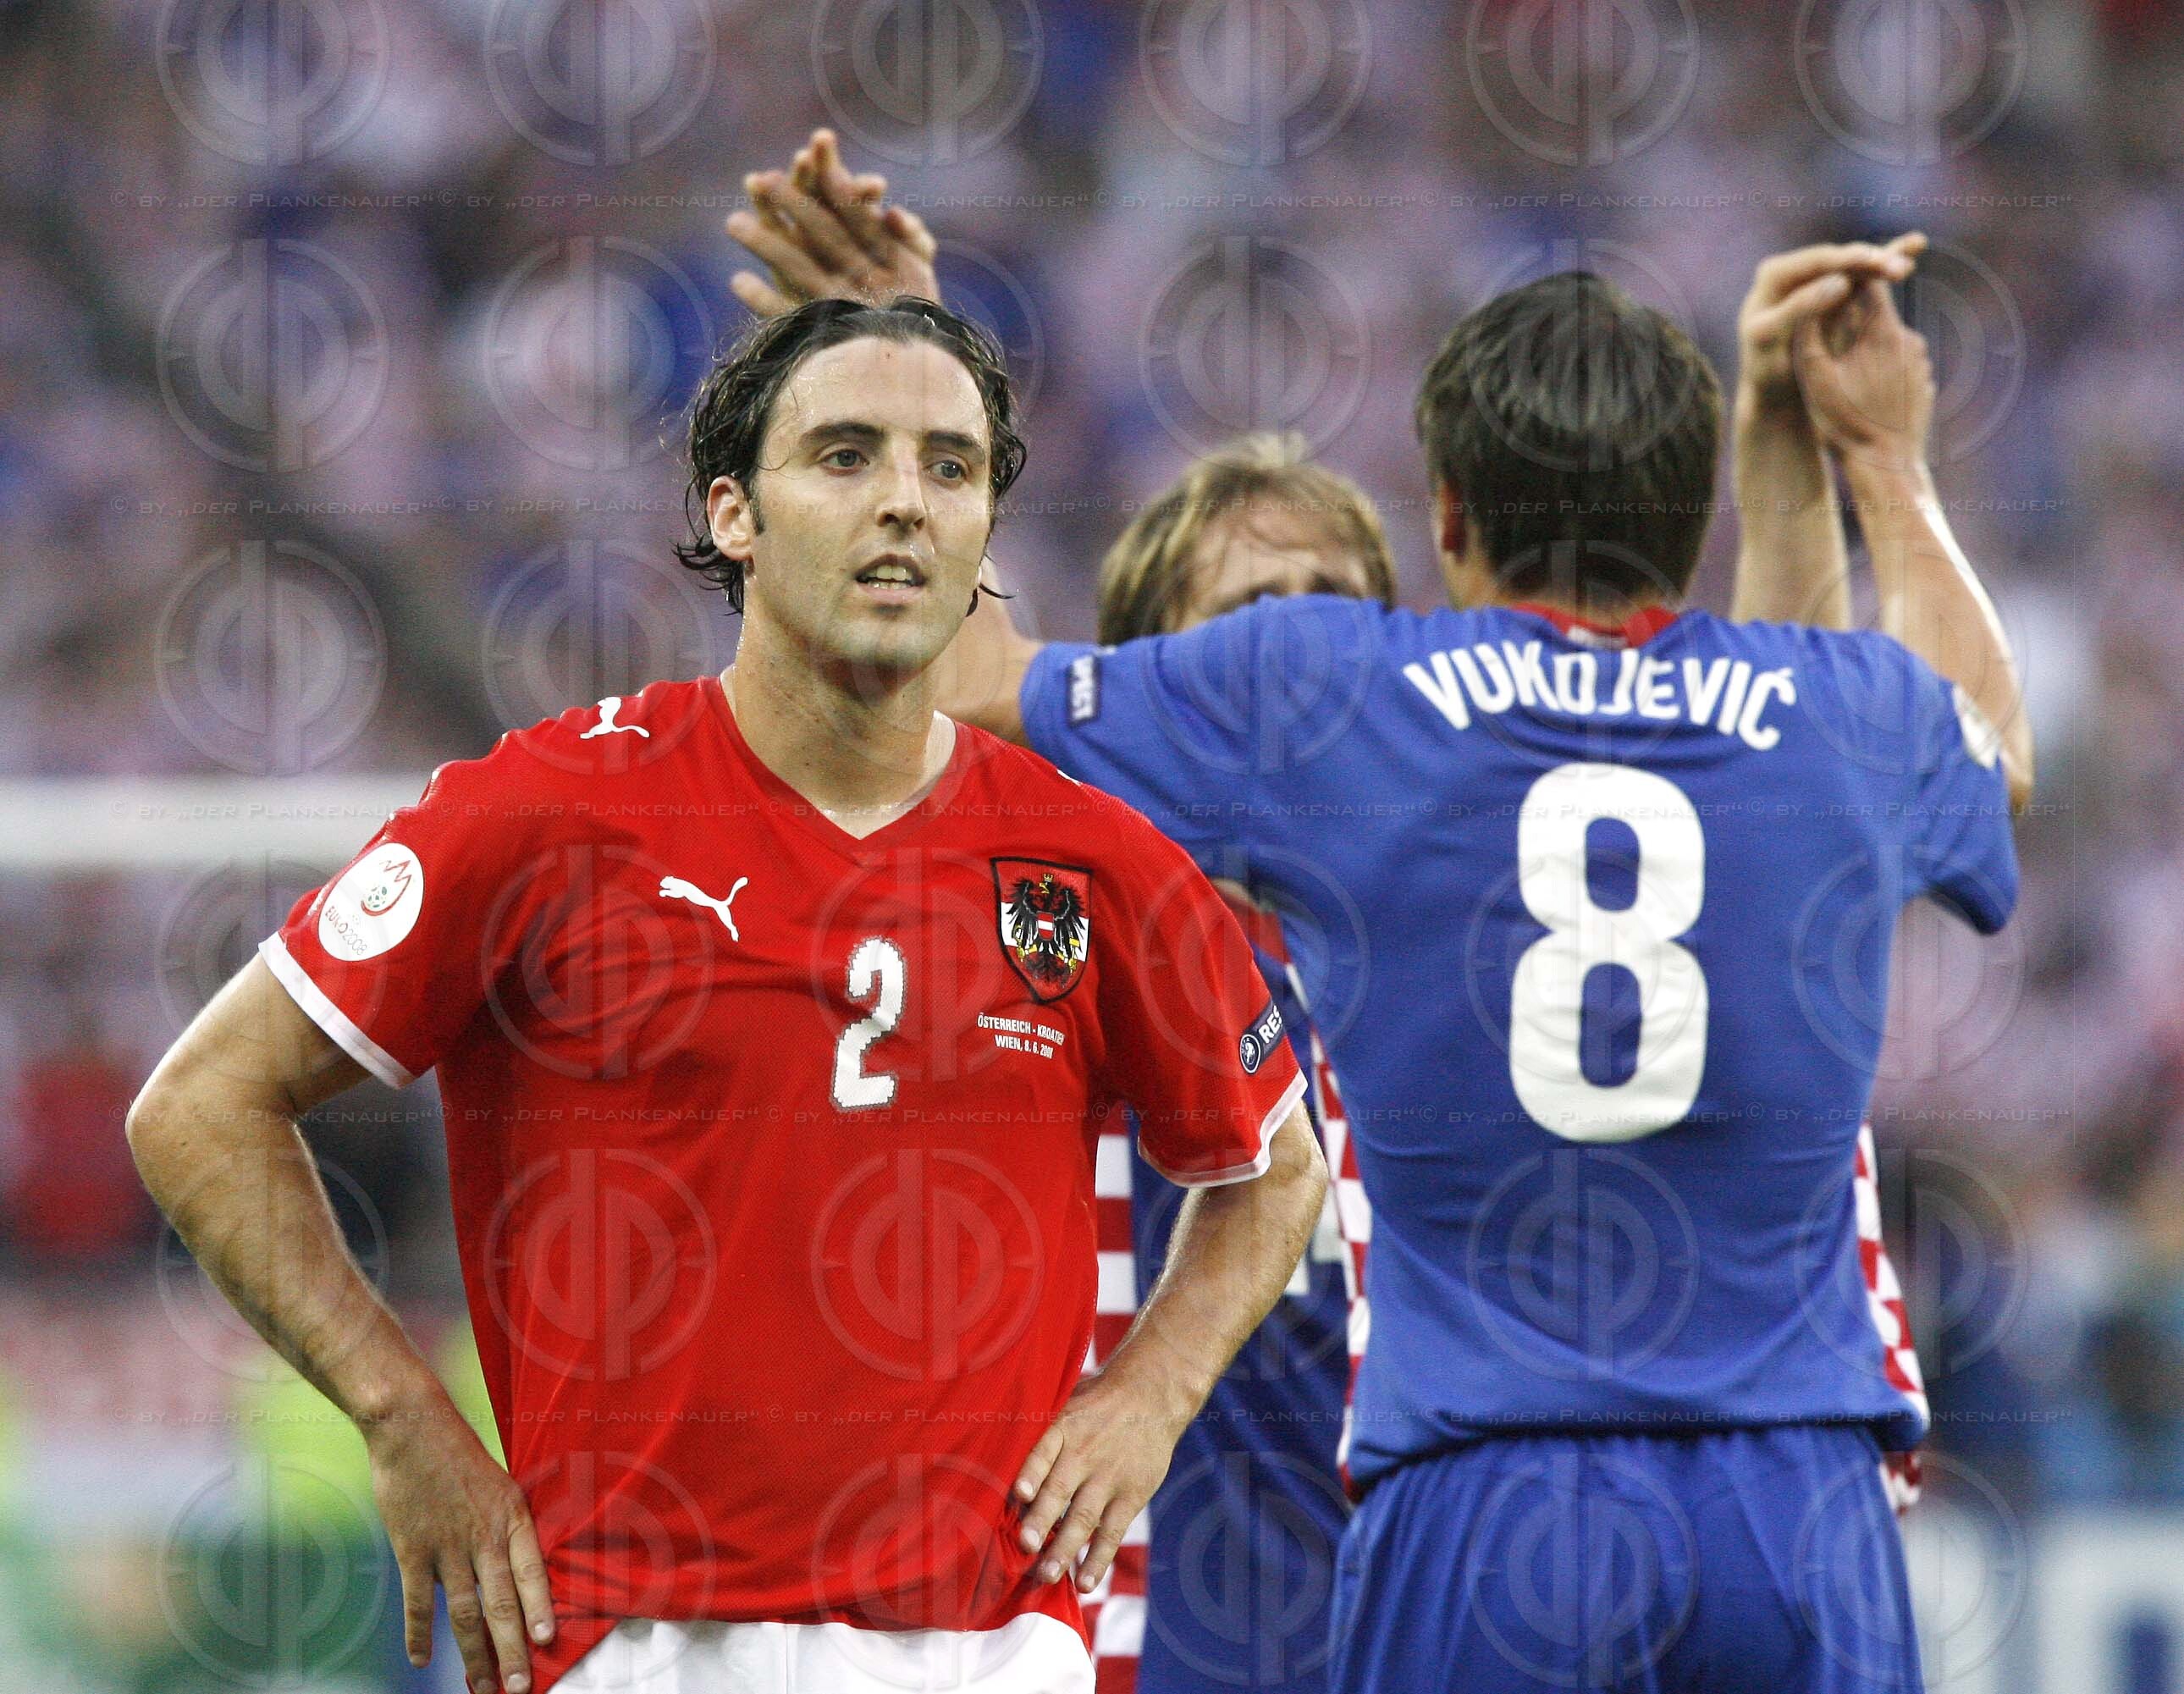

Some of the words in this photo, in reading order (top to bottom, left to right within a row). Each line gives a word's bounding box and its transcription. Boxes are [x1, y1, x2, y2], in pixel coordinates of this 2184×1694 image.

[1403, 640, 1796, 749] VUKOJEVIĆ
[1509, 762, 1708, 1144] 8
[831, 937, 905, 1110] 2
[977, 1012, 1031, 1034] ÖSTERREICH
[995, 1035, 1023, 1051] WIEN,
